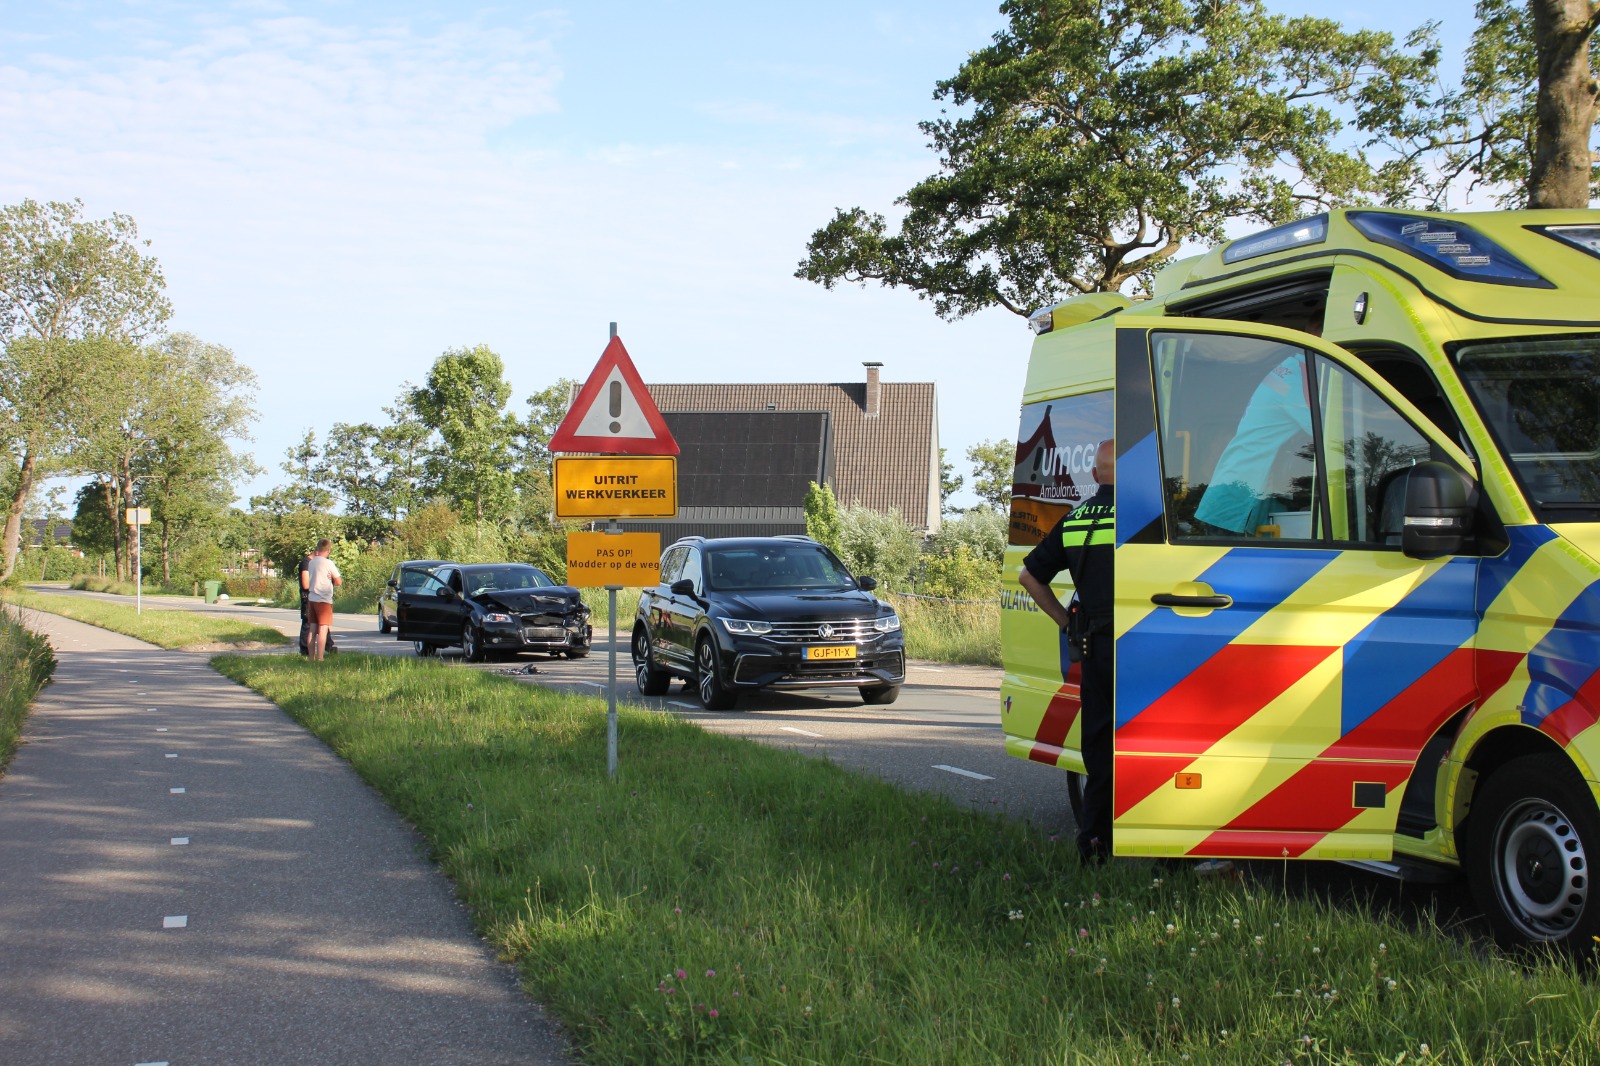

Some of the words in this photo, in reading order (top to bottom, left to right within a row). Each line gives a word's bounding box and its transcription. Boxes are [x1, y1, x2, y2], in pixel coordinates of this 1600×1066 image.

[594, 475, 638, 485] UITRIT
[565, 489, 666, 499] WERKVERKEER
[1040, 481, 1097, 498] Ambulancezorg
[596, 549, 615, 558] PAS
[617, 549, 633, 558] OP!
[569, 560, 607, 569] Modder
[610, 562, 622, 571] op
[625, 560, 637, 569] de
[640, 562, 660, 571] weg
[813, 648, 851, 658] GJF-11-X
